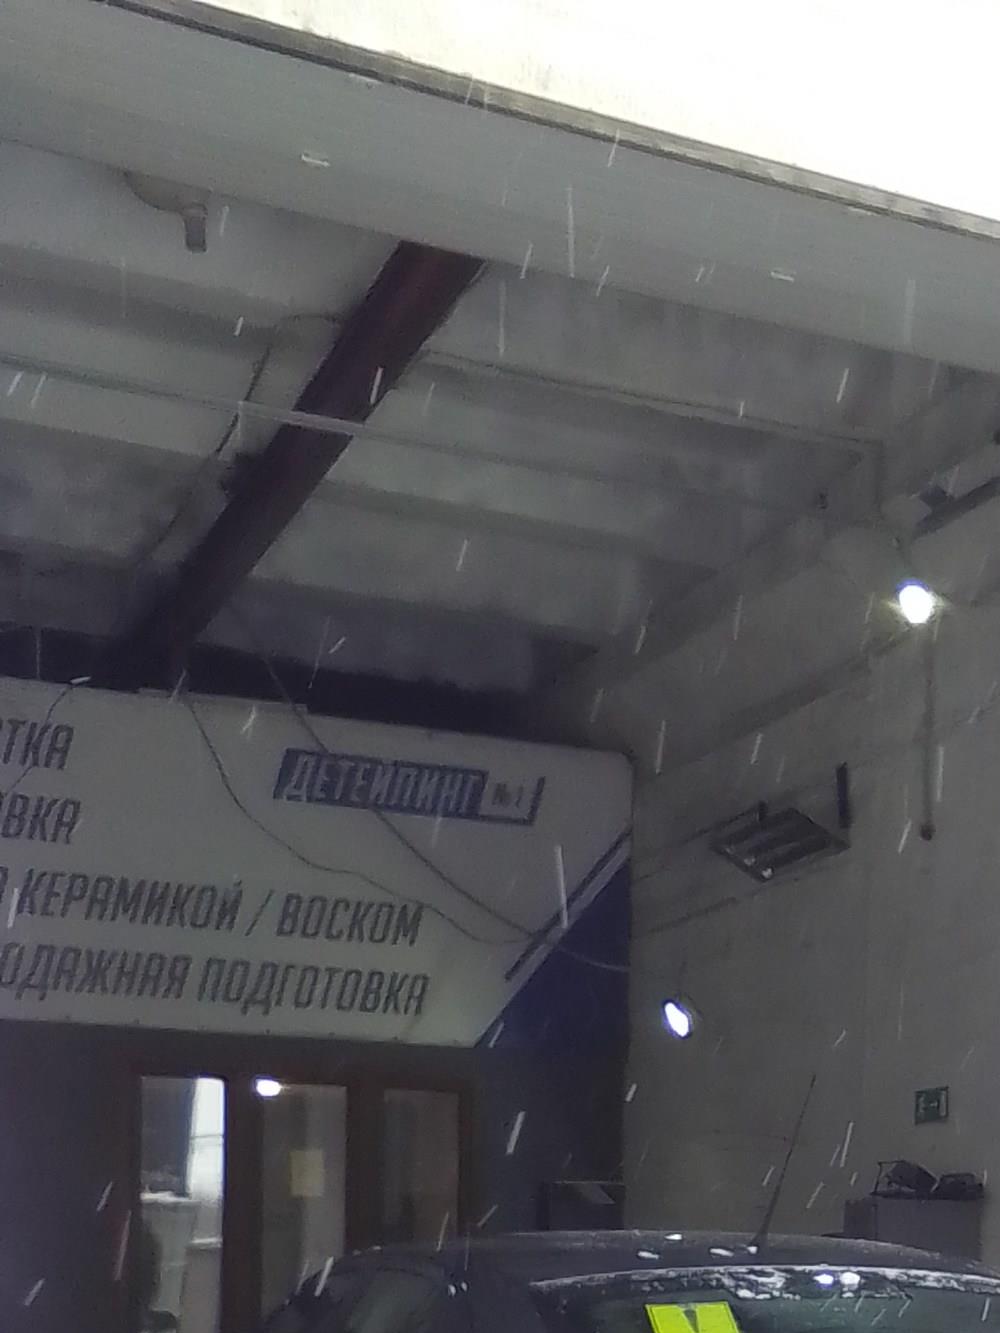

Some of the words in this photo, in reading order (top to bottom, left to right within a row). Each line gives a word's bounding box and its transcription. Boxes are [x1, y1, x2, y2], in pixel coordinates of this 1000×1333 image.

[0, 718, 74, 770] ТКА
[0, 793, 81, 845] ВКА
[16, 867, 244, 929] КЕРАМИКОЙ
[276, 893, 424, 947] ВОСКОМ
[198, 956, 430, 1017] ПОДГОТОВКА
